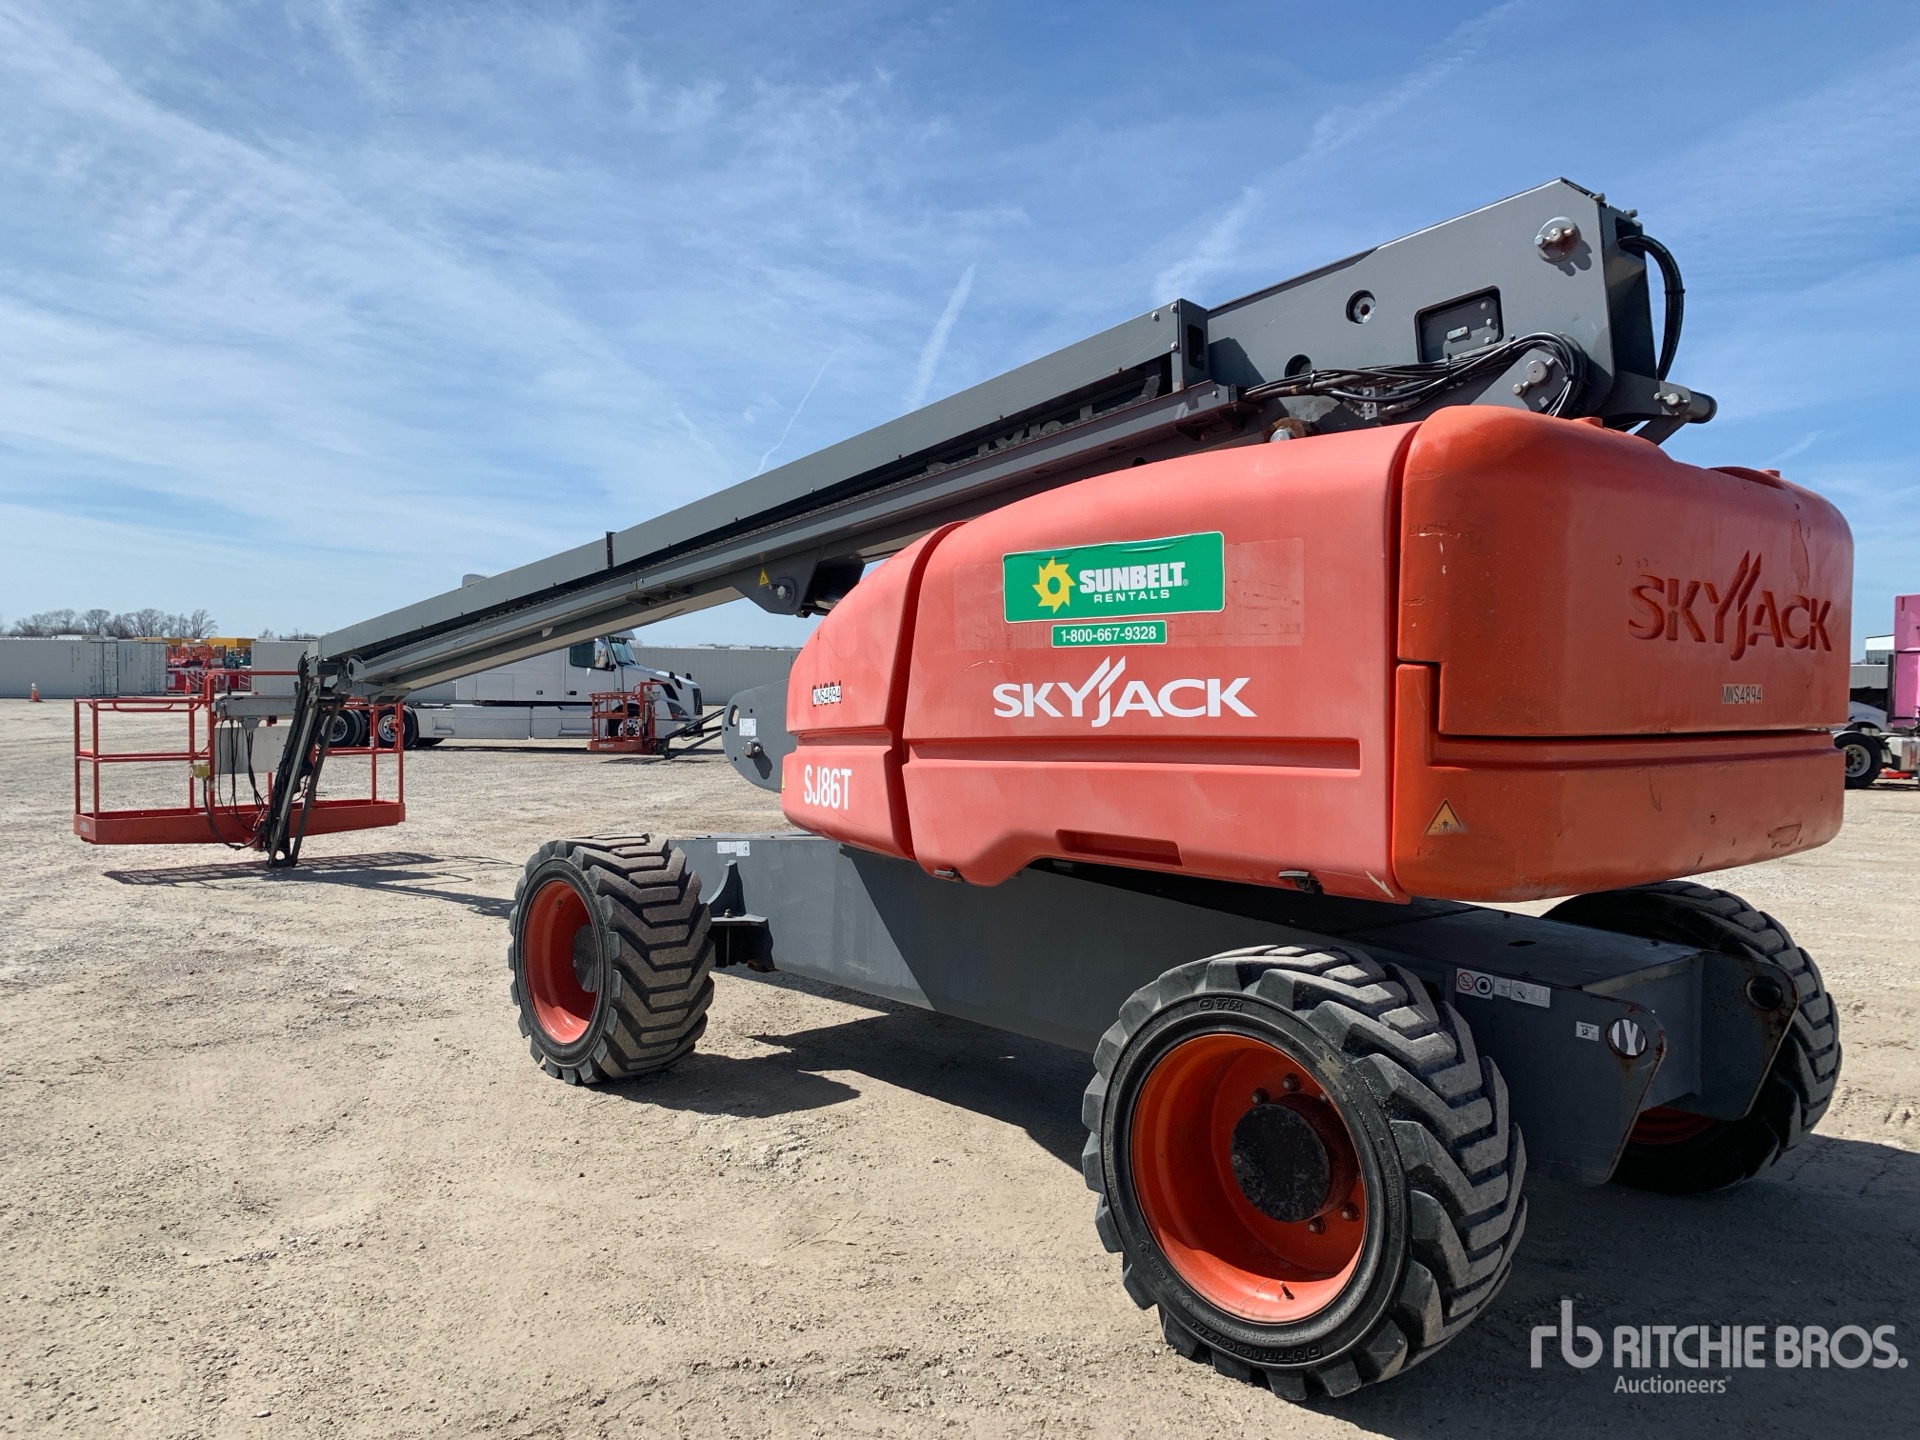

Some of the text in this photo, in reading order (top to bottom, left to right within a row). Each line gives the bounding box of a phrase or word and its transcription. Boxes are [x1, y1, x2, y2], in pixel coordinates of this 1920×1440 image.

[1079, 561, 1186, 594] SUNBELT
[1094, 589, 1171, 604] RENTALS
[1628, 550, 1832, 661] SKYJACK
[1060, 626, 1157, 643] 1-800-667-9328
[992, 655, 1258, 728] SKYJACK
[1721, 685, 1762, 704] MWS4894
[803, 764, 852, 810] SJ86T
[1199, 997, 1243, 1012] OTR
